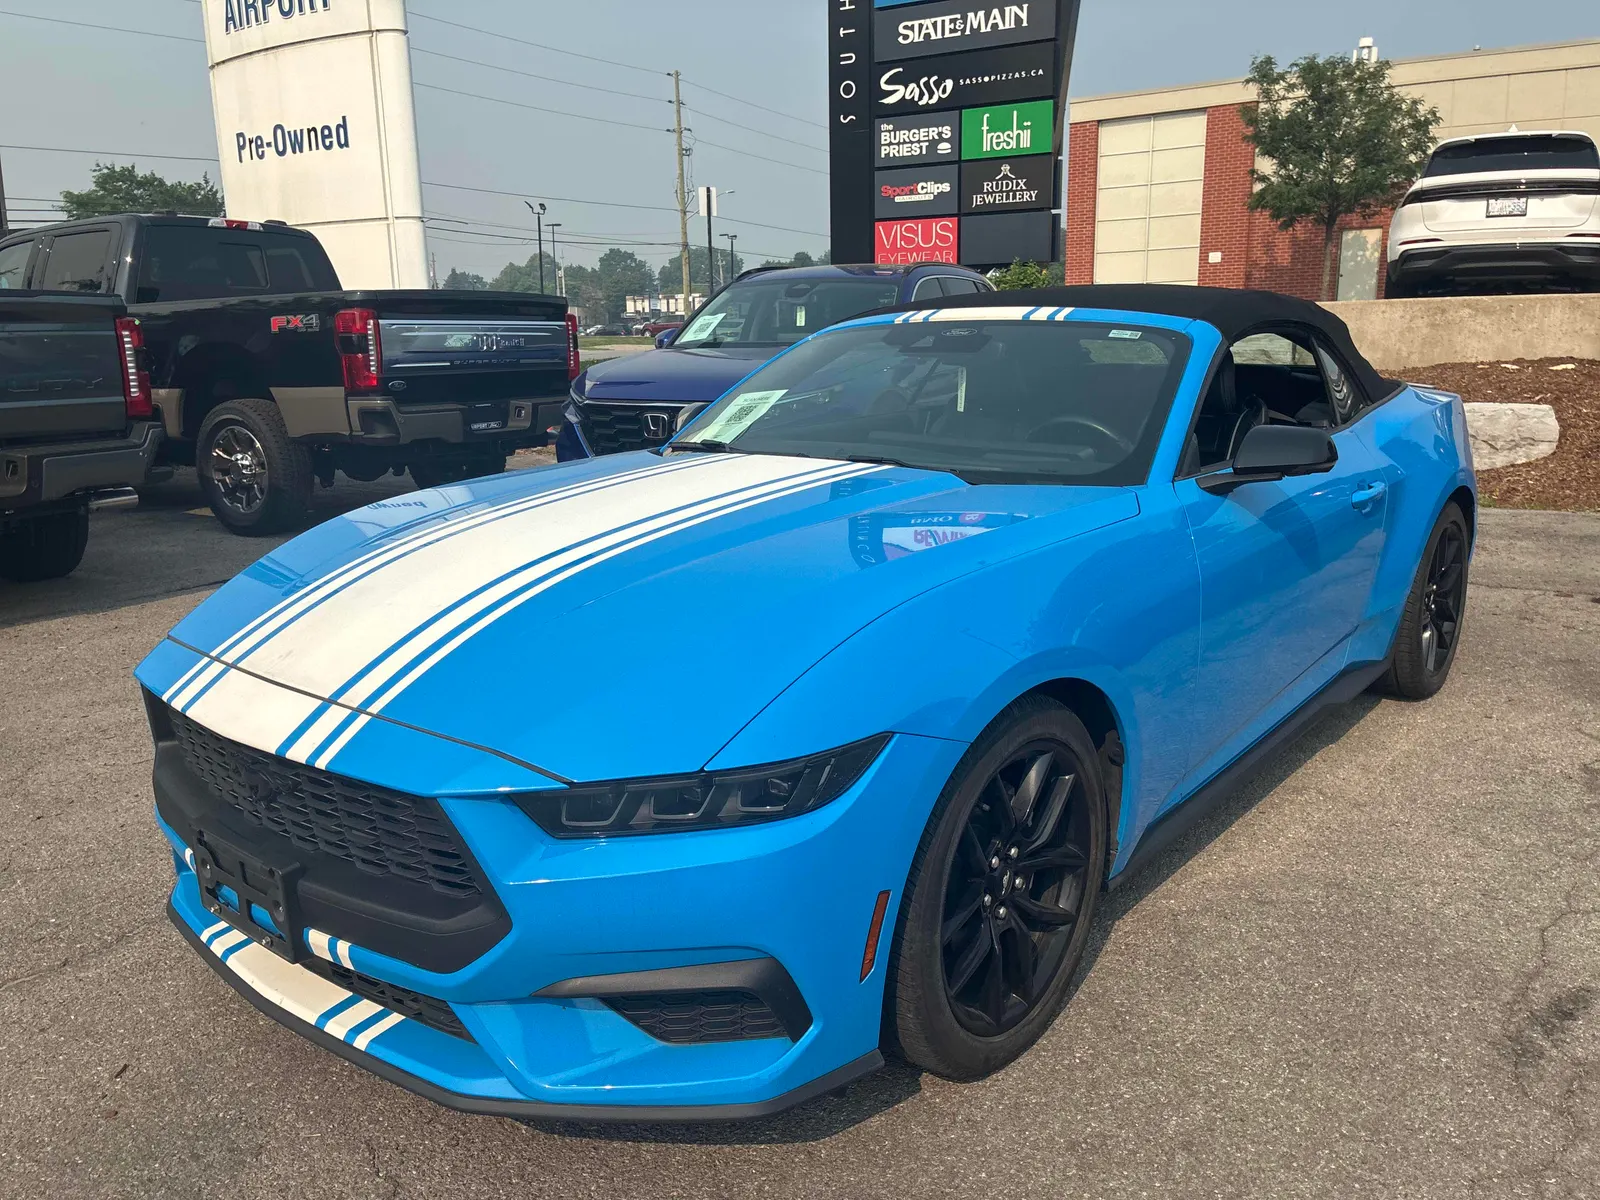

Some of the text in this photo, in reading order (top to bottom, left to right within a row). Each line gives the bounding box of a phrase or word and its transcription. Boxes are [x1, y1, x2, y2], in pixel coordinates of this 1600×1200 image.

[224, 0, 331, 34] AIRPO
[878, 67, 954, 106] Sasso
[880, 123, 894, 131] the
[880, 125, 952, 144] BURGER'S
[981, 110, 1032, 152] freshii
[235, 115, 350, 164] Pre-Owned
[880, 142, 930, 158] PRIEST
[982, 178, 1028, 193] RUDIX
[972, 190, 1039, 208] JEWELLERY
[878, 221, 953, 249] VISUS
[877, 250, 953, 265] EYEWEAR
[270, 313, 320, 333] FX4
